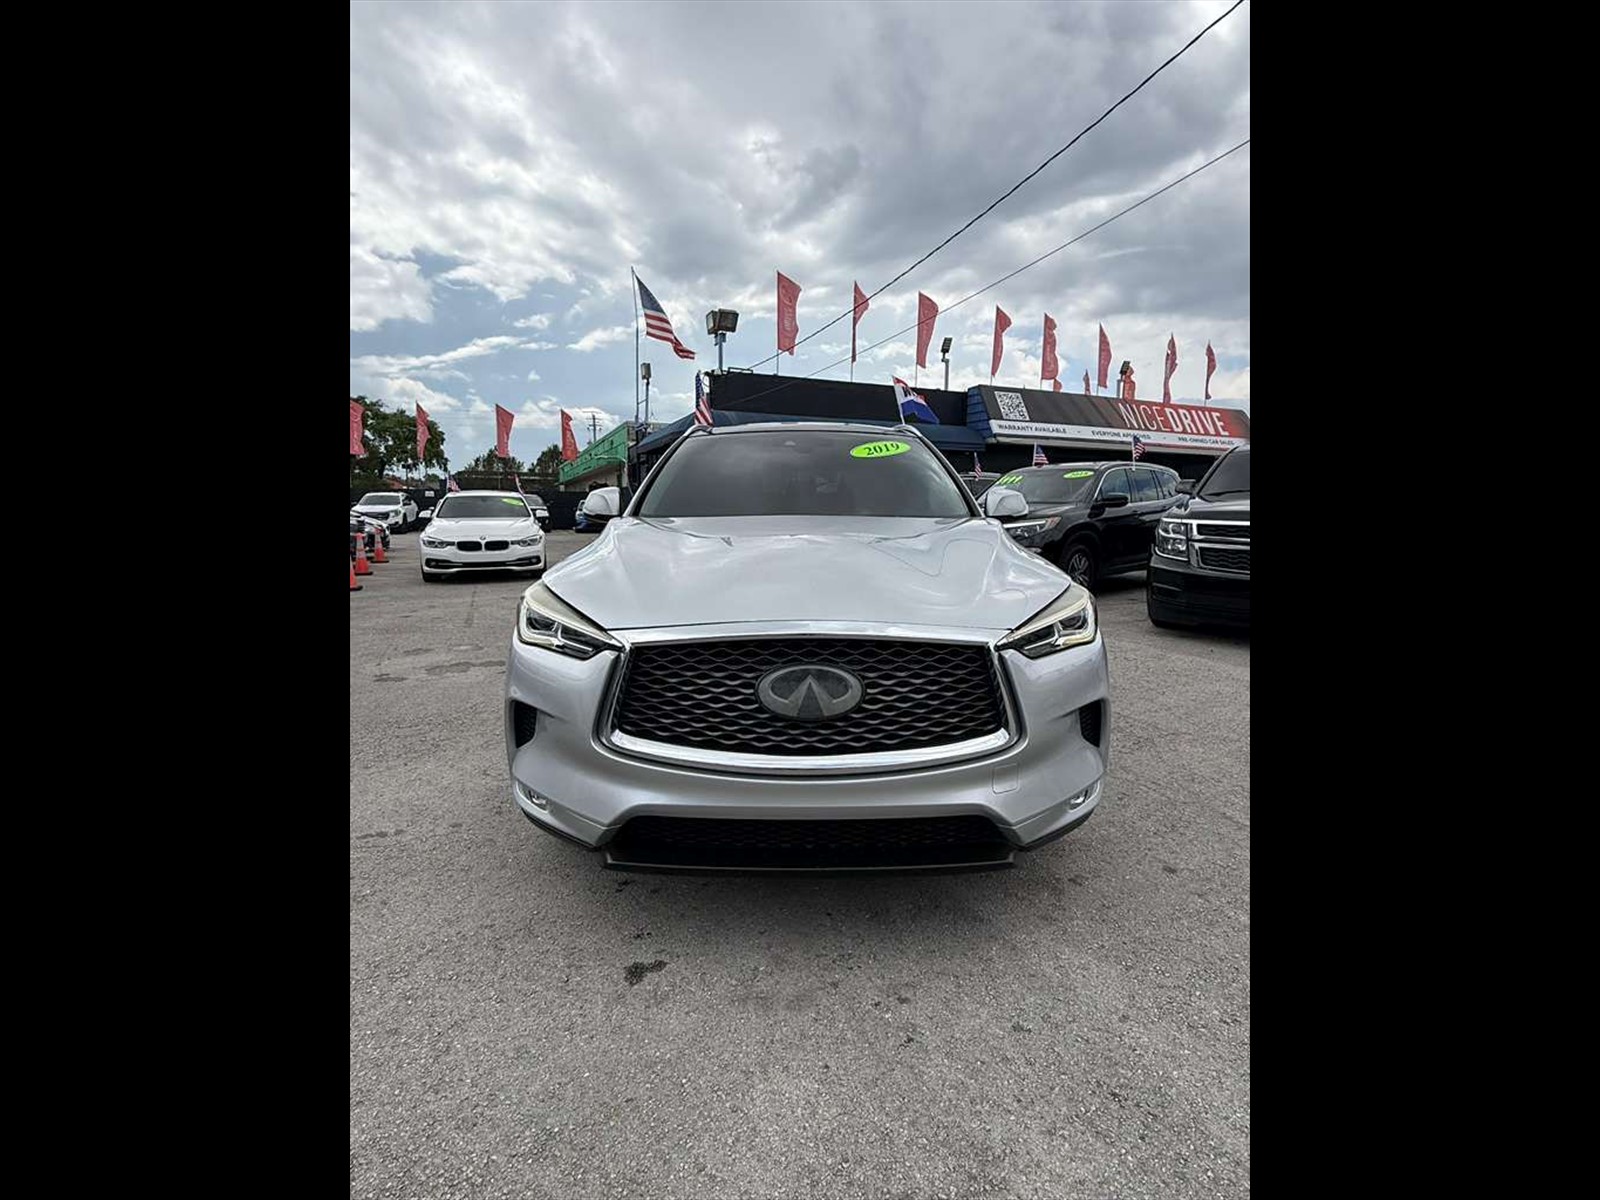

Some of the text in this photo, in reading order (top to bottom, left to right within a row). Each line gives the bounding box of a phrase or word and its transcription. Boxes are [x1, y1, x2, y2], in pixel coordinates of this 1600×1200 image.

[997, 423, 1067, 434] WARRANTY AVAILABLE
[1091, 430, 1121, 438] EVERYONE
[863, 443, 900, 456] 2019
